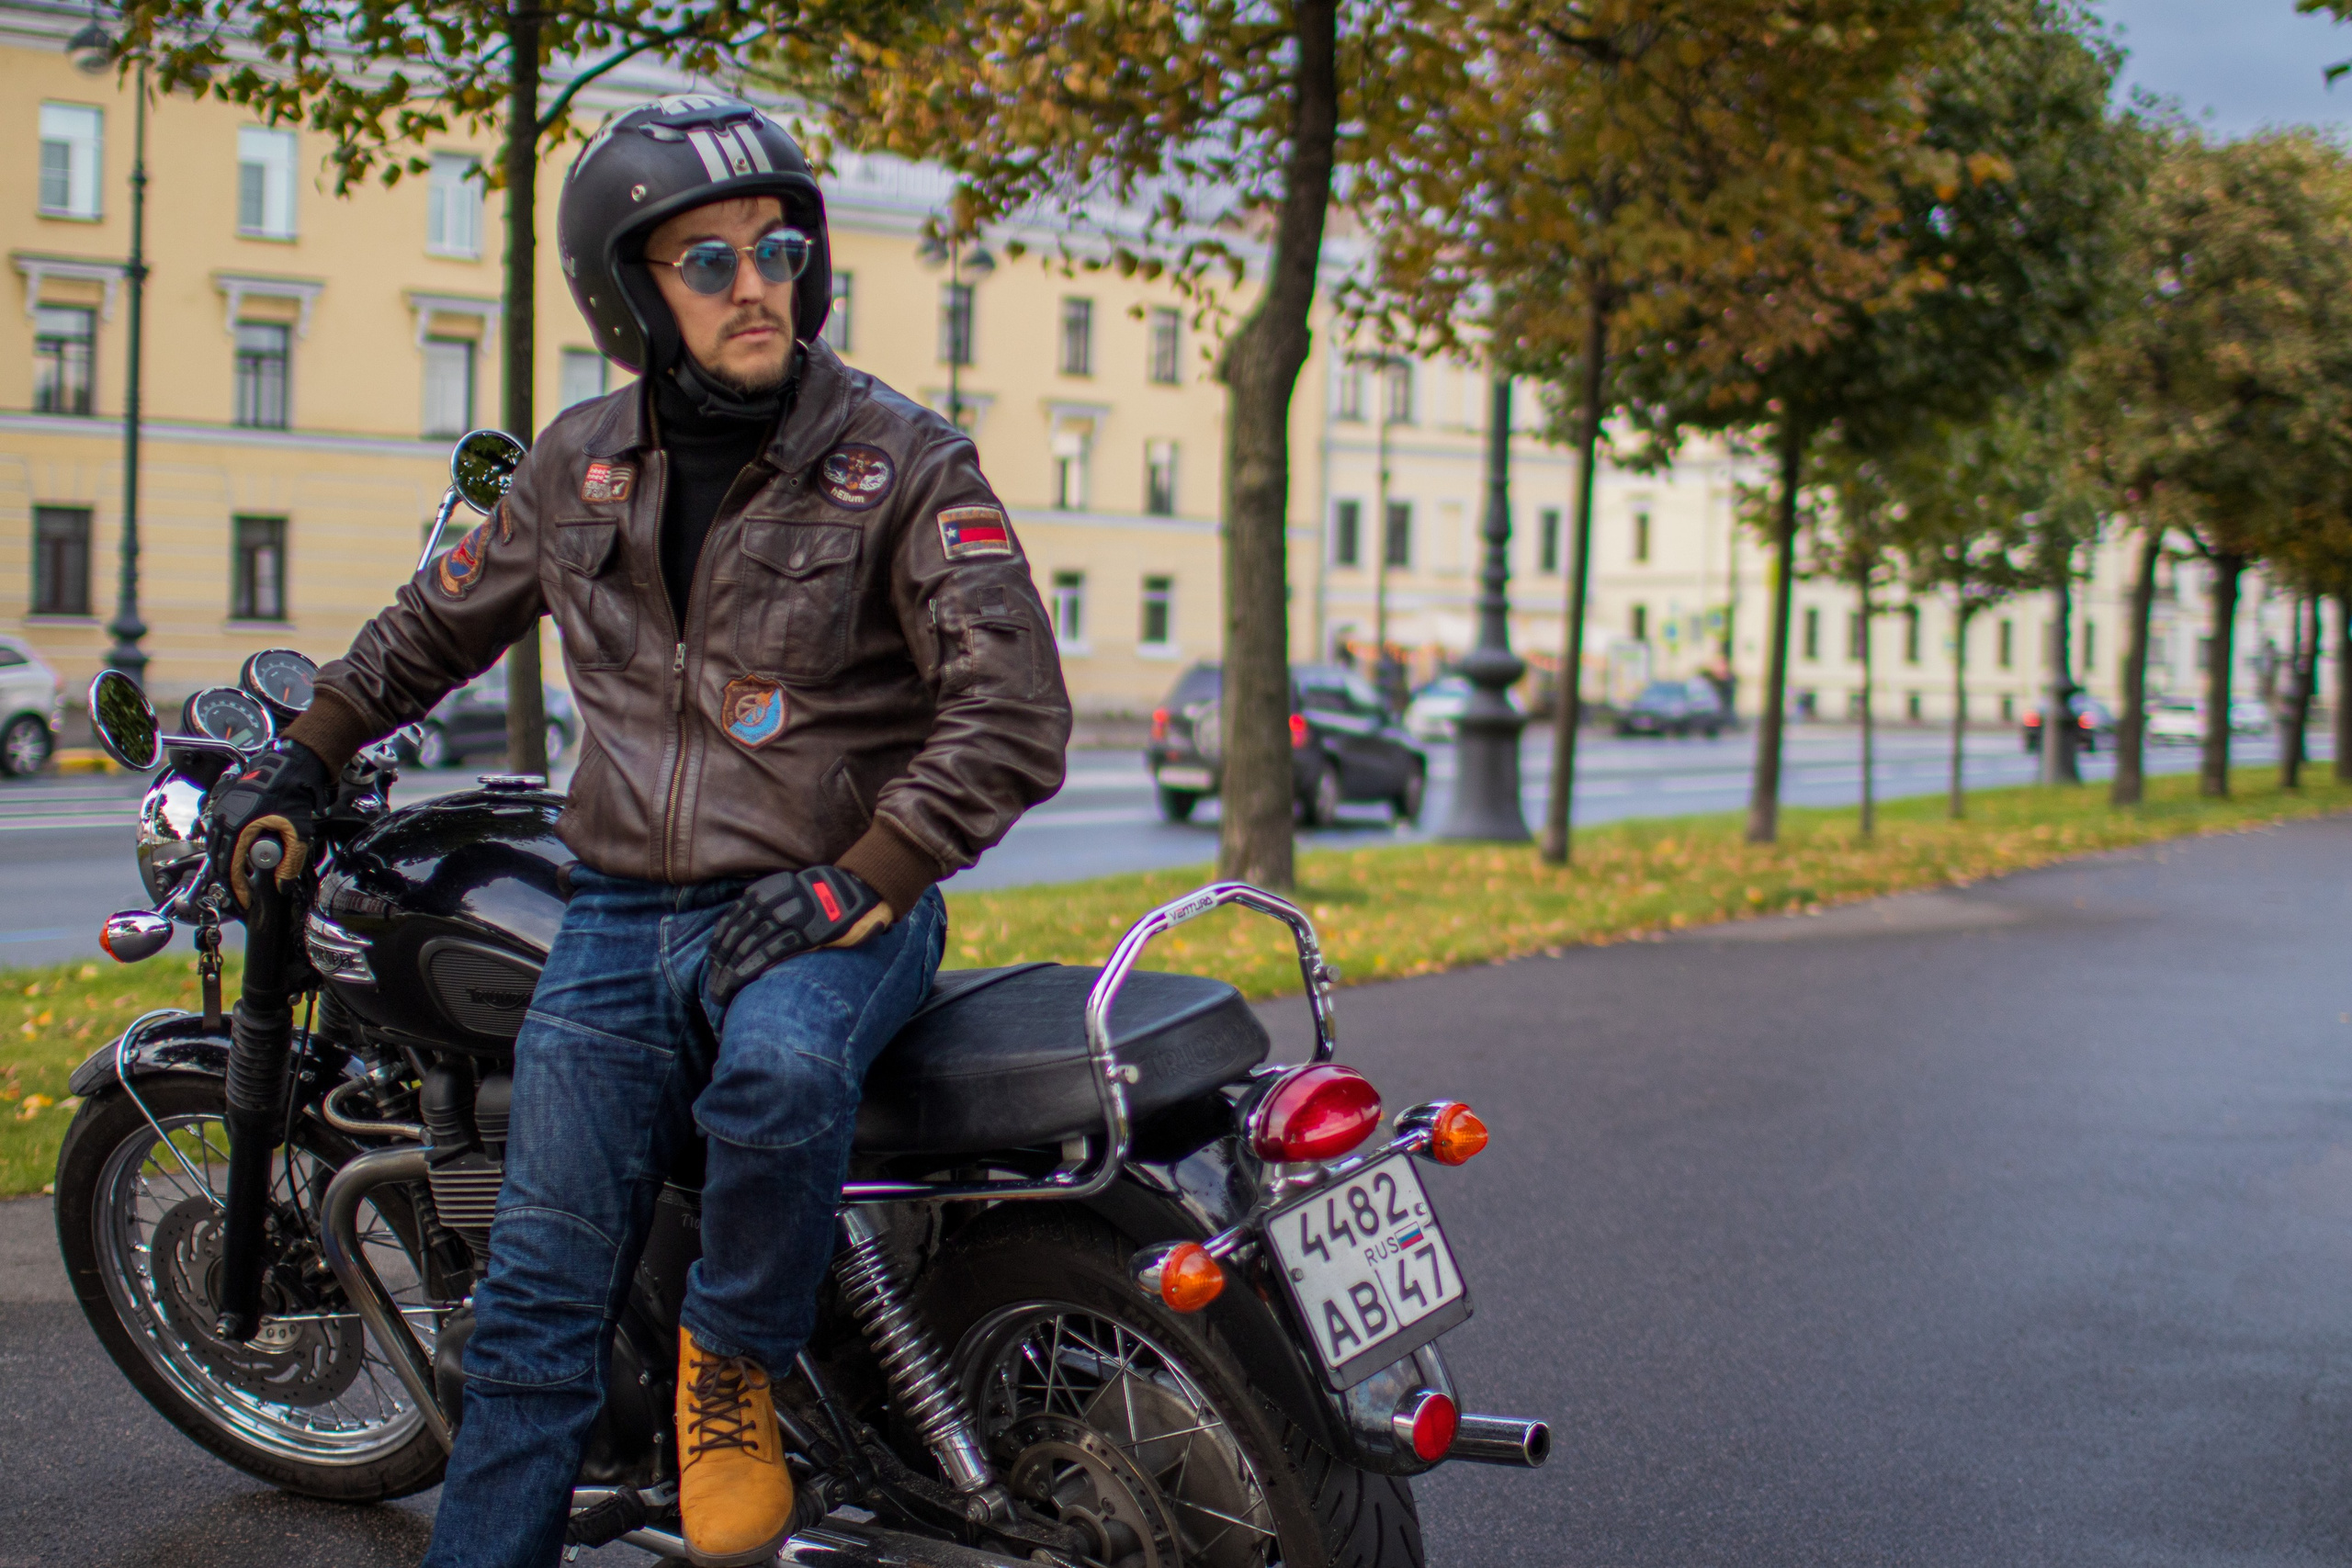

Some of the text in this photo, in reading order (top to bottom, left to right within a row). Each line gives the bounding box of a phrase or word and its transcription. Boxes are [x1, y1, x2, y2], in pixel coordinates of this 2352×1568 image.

[830, 486, 865, 503] hElium
[1169, 896, 1214, 921] VENTURA
[1299, 1172, 1409, 1262] 4482
[1363, 1236, 1398, 1267] RUS
[1322, 1242, 1444, 1358] AB 47
